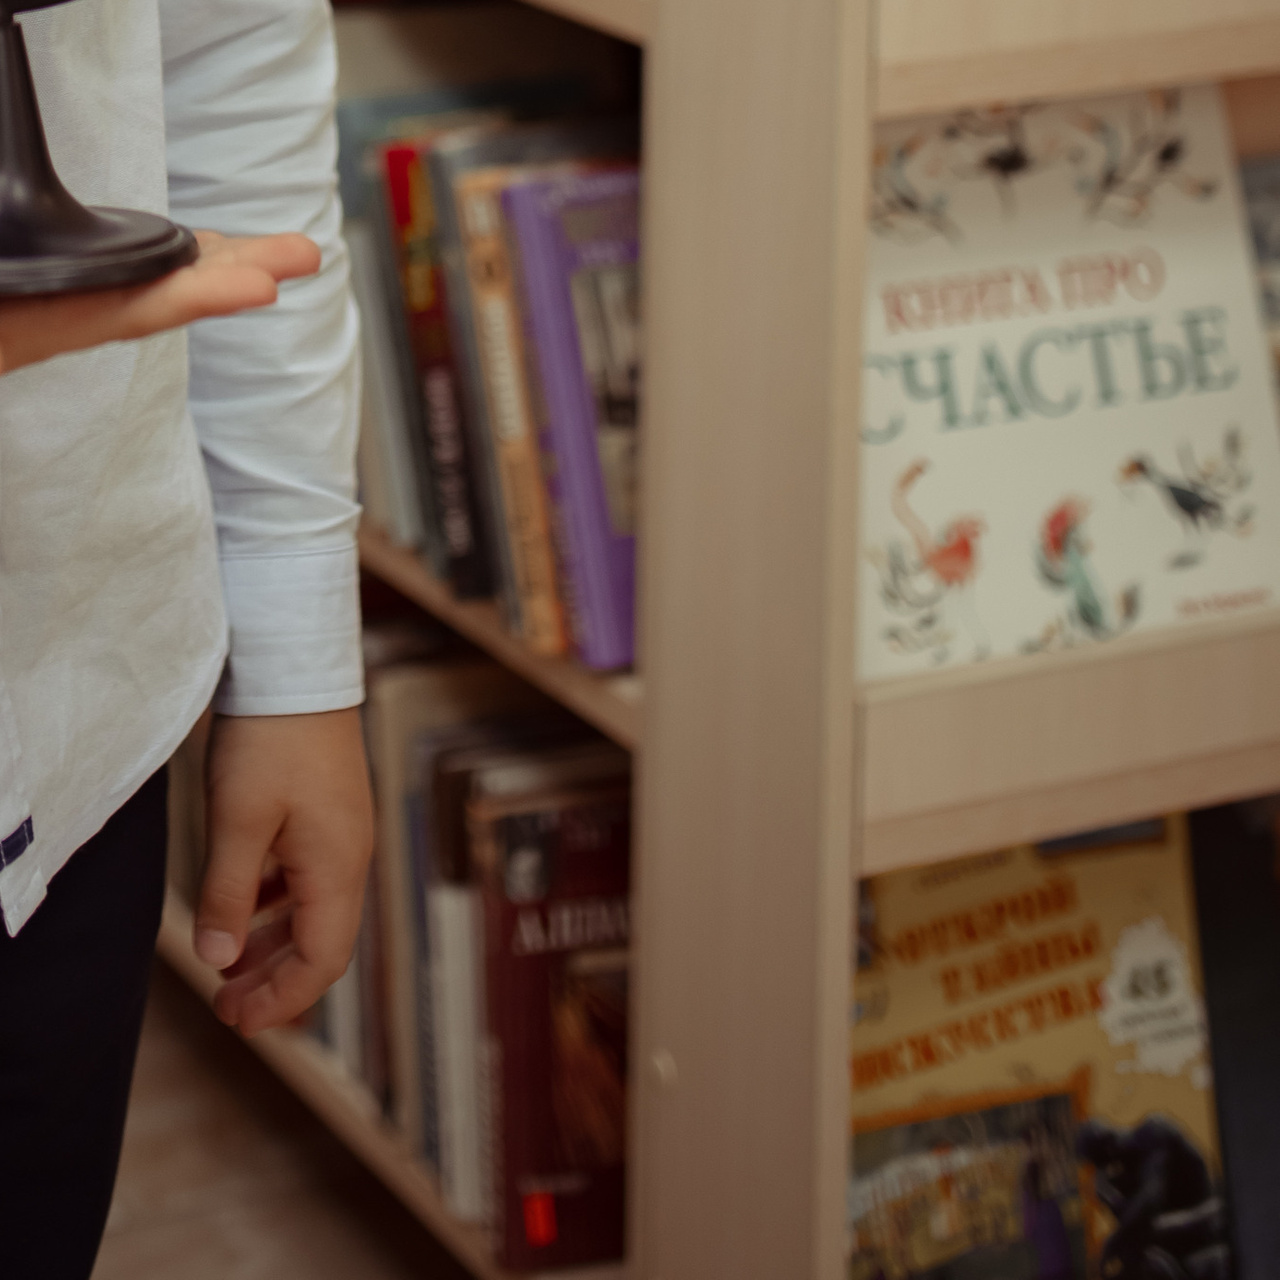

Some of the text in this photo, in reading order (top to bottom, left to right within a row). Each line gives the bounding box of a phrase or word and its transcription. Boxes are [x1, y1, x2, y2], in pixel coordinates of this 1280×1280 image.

[881, 245, 1167, 335] КНИГА ПРО
[863, 304, 1240, 444] СЧАСТЬЕ
